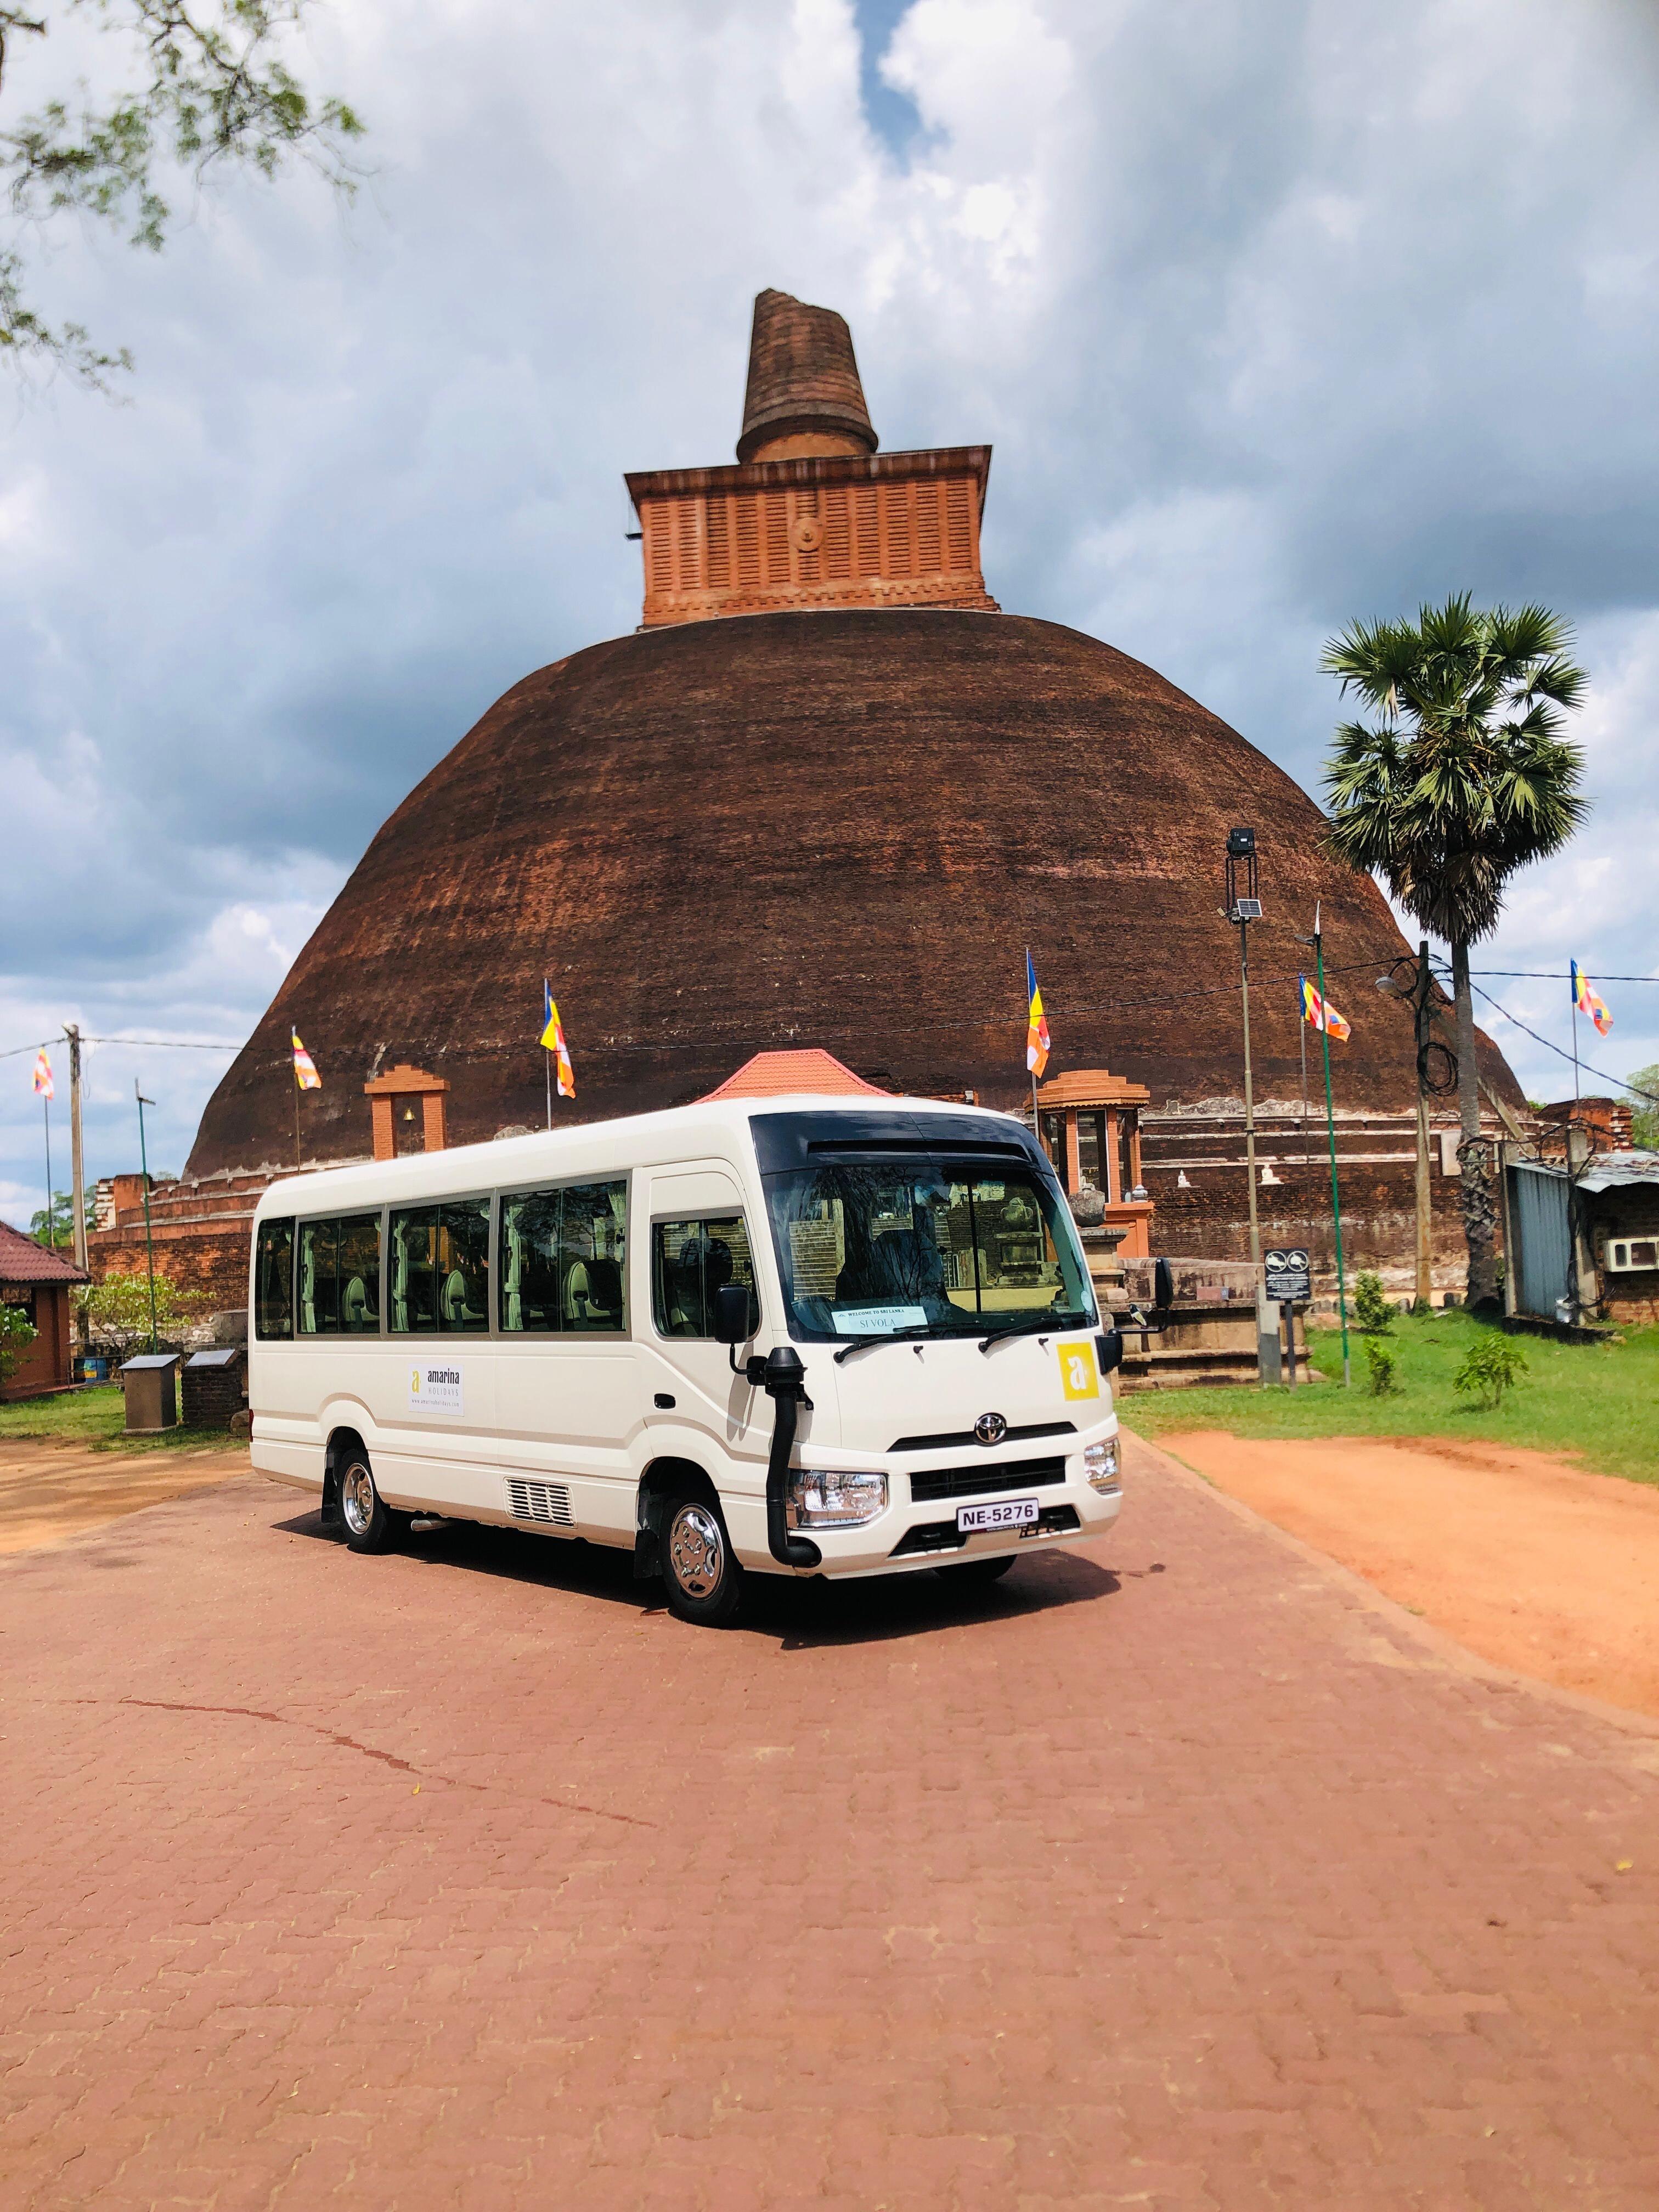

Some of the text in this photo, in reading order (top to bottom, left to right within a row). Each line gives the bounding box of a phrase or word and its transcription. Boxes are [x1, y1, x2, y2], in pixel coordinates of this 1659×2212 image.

[860, 1319, 896, 1328] SI VOLA
[428, 1368, 459, 1384] amarina
[1068, 1356, 1087, 1390] a
[428, 1387, 459, 1397] HOLIDAYS
[963, 1504, 1033, 1526] NE-5276
